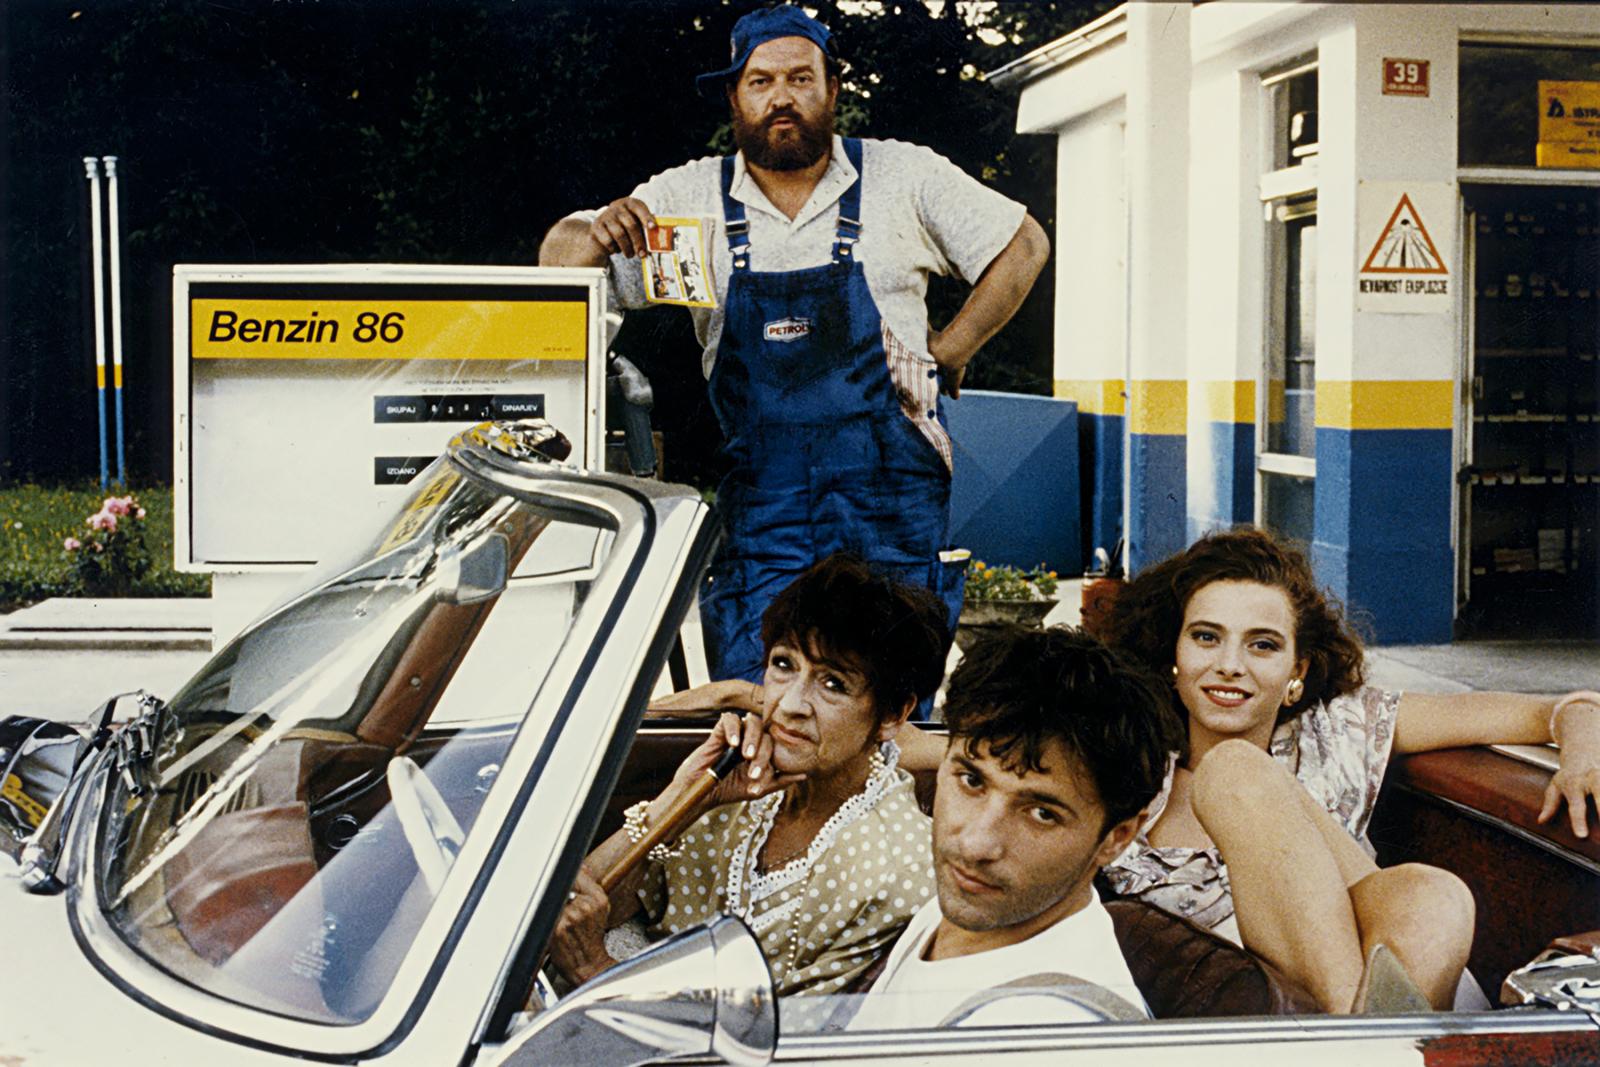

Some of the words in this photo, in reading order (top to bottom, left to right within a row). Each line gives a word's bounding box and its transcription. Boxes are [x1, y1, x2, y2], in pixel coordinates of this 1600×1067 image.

[1393, 62, 1419, 83] 39
[208, 310, 339, 343] Benzin
[353, 311, 406, 344] 86
[769, 323, 807, 336] PETROL
[386, 405, 416, 414] SKUPAJ
[386, 467, 417, 475] IZDANO
